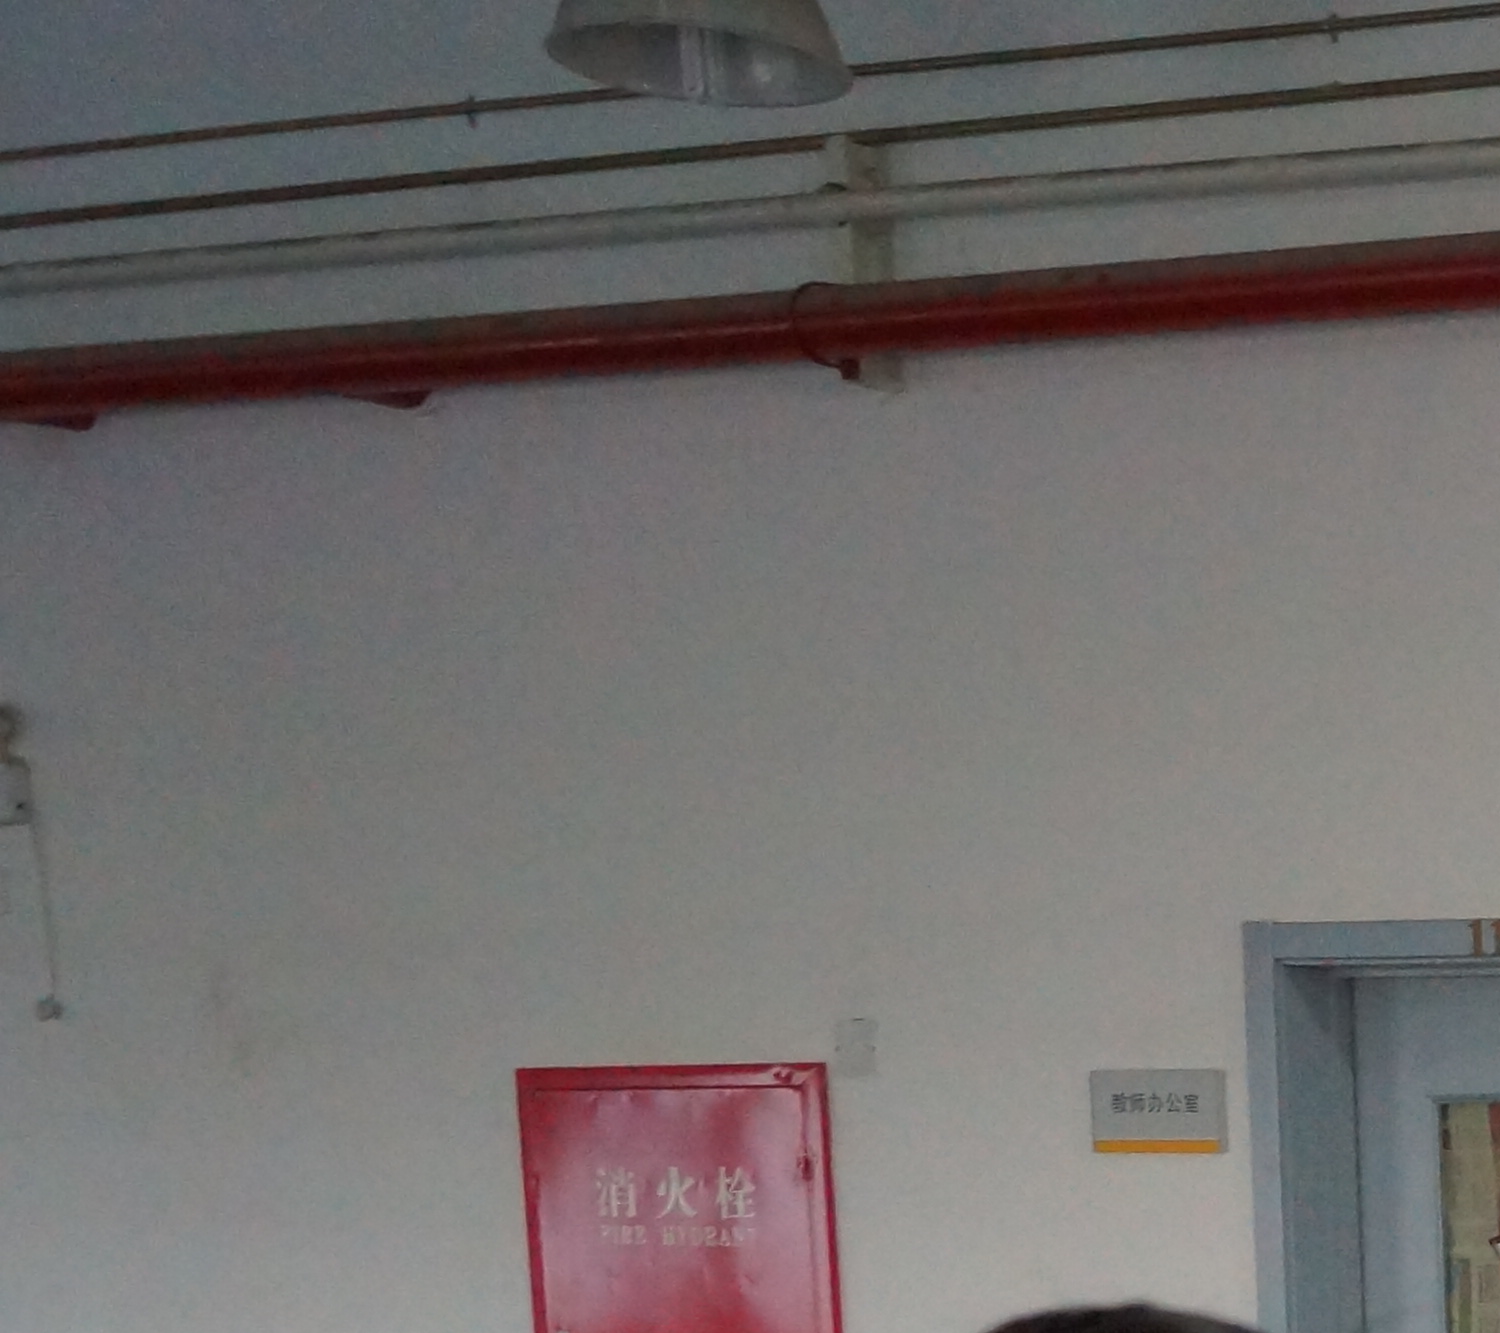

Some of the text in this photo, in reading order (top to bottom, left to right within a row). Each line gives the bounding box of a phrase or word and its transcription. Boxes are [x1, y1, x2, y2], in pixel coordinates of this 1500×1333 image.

[1111, 1092, 1199, 1113] 教师办公室
[597, 1166, 756, 1219] 消火栓
